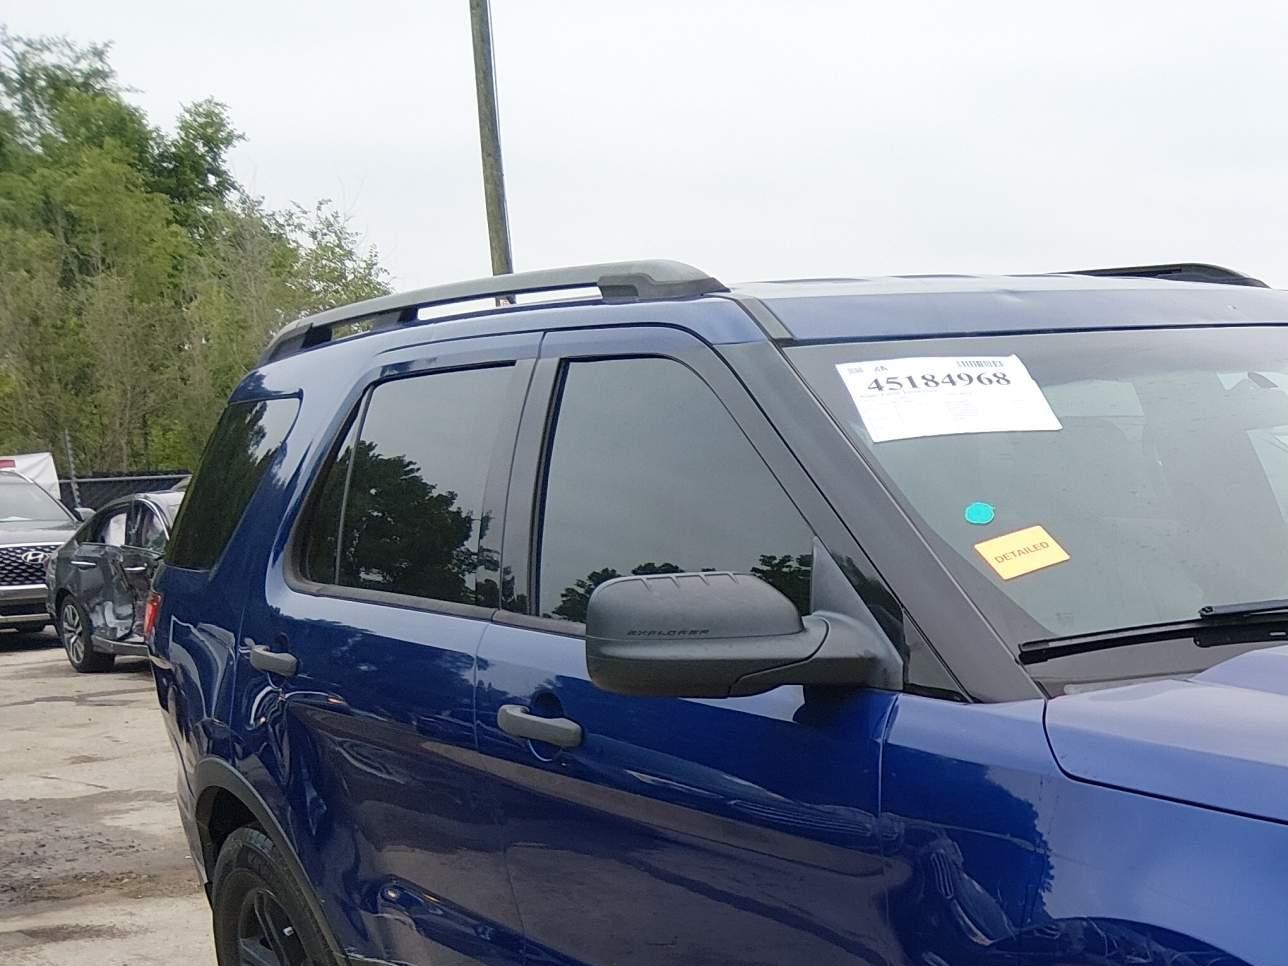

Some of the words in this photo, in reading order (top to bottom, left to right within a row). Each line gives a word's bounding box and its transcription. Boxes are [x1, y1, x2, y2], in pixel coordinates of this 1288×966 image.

[867, 371, 1012, 392] 45184968
[994, 541, 1050, 564] DETAILED
[626, 629, 710, 637] EXPLORER
